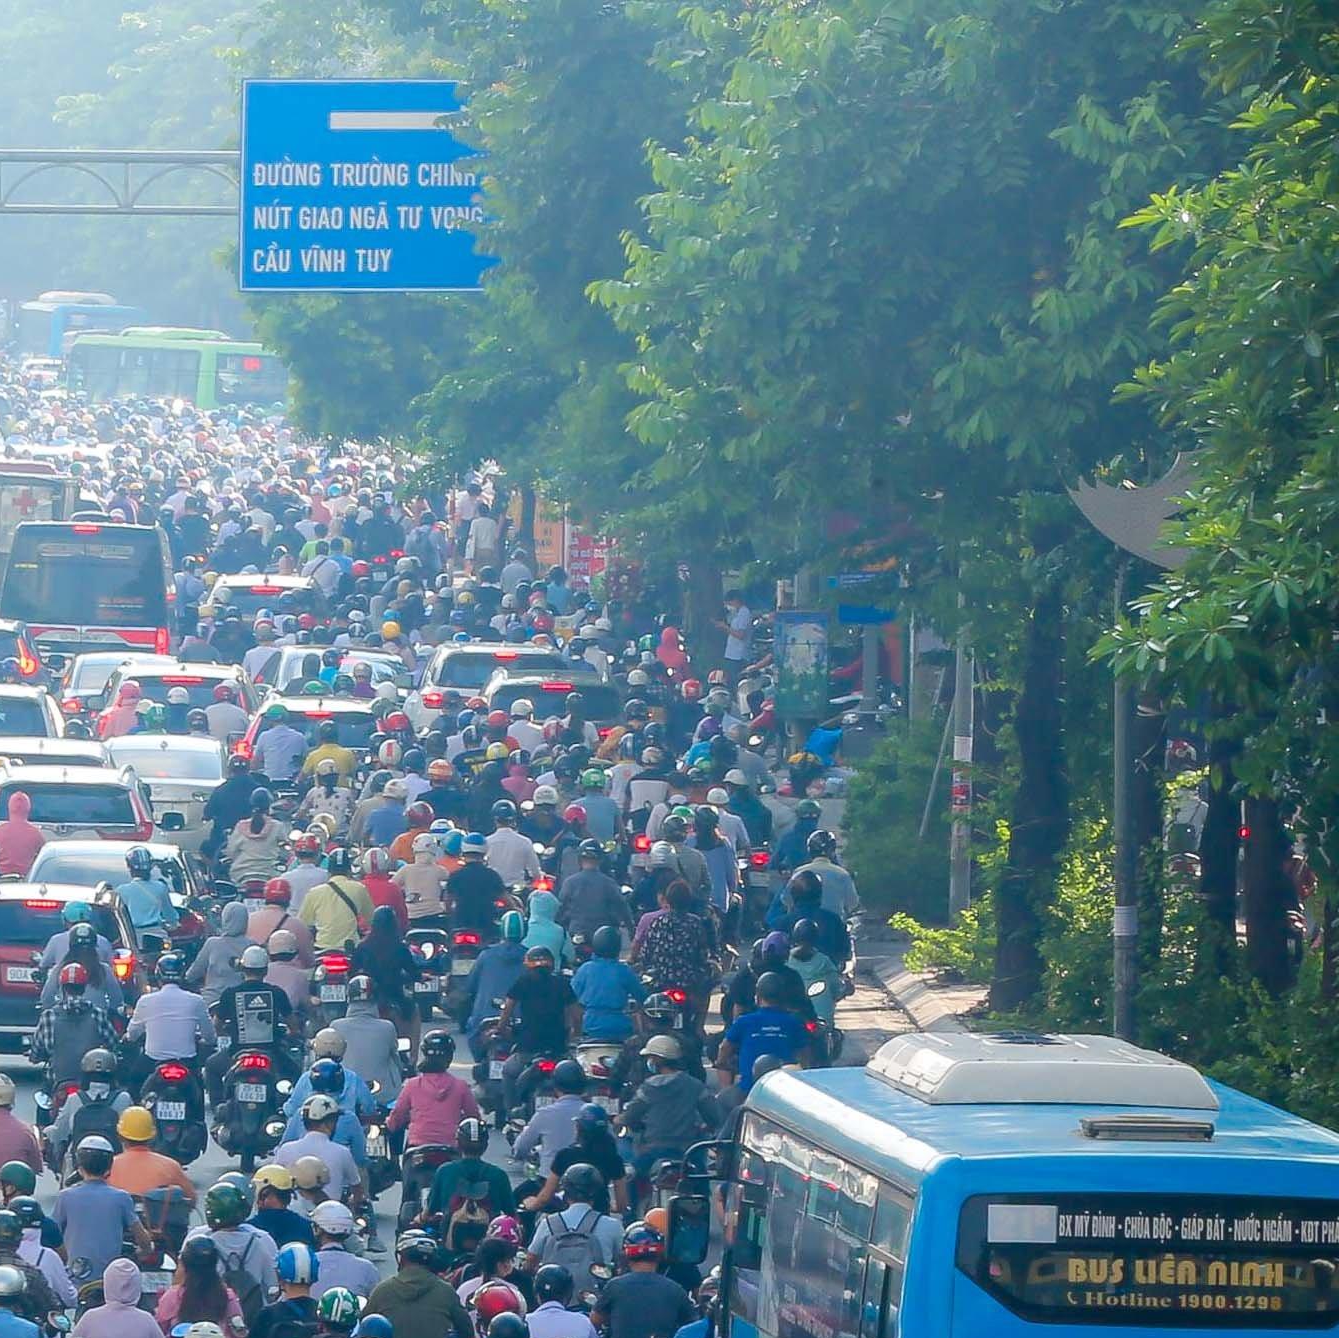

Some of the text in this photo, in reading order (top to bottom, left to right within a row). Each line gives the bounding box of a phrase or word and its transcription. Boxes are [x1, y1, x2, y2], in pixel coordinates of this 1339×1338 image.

[252, 156, 321, 187] ĐƯỜNG
[330, 156, 409, 187] TRƯỜNG
[253, 199, 292, 230] NÚT
[299, 205, 342, 230] GIAO
[350, 201, 389, 230] NGÃ
[397, 205, 423, 230] TƯ
[253, 241, 392, 272] CẦU VĨNH TUY
[1059, 1215, 1072, 1237] BX
[1074, 1210, 1090, 1237] MỸ
[1092, 1210, 1116, 1238] ĐÌNH
[1124, 1211, 1149, 1239] CHÙA
[1152, 1212, 1172, 1243] BỘC
[1181, 1213, 1203, 1240] GIÁP
[1206, 1214, 1225, 1240] BÁT
[1234, 1212, 1260, 1241] NƯỚC
[1301, 1220, 1319, 1243] KĐT
[1067, 1254, 1284, 1287] BUS LIÊN NINH
[1085, 1291, 1172, 1308] Hotline
